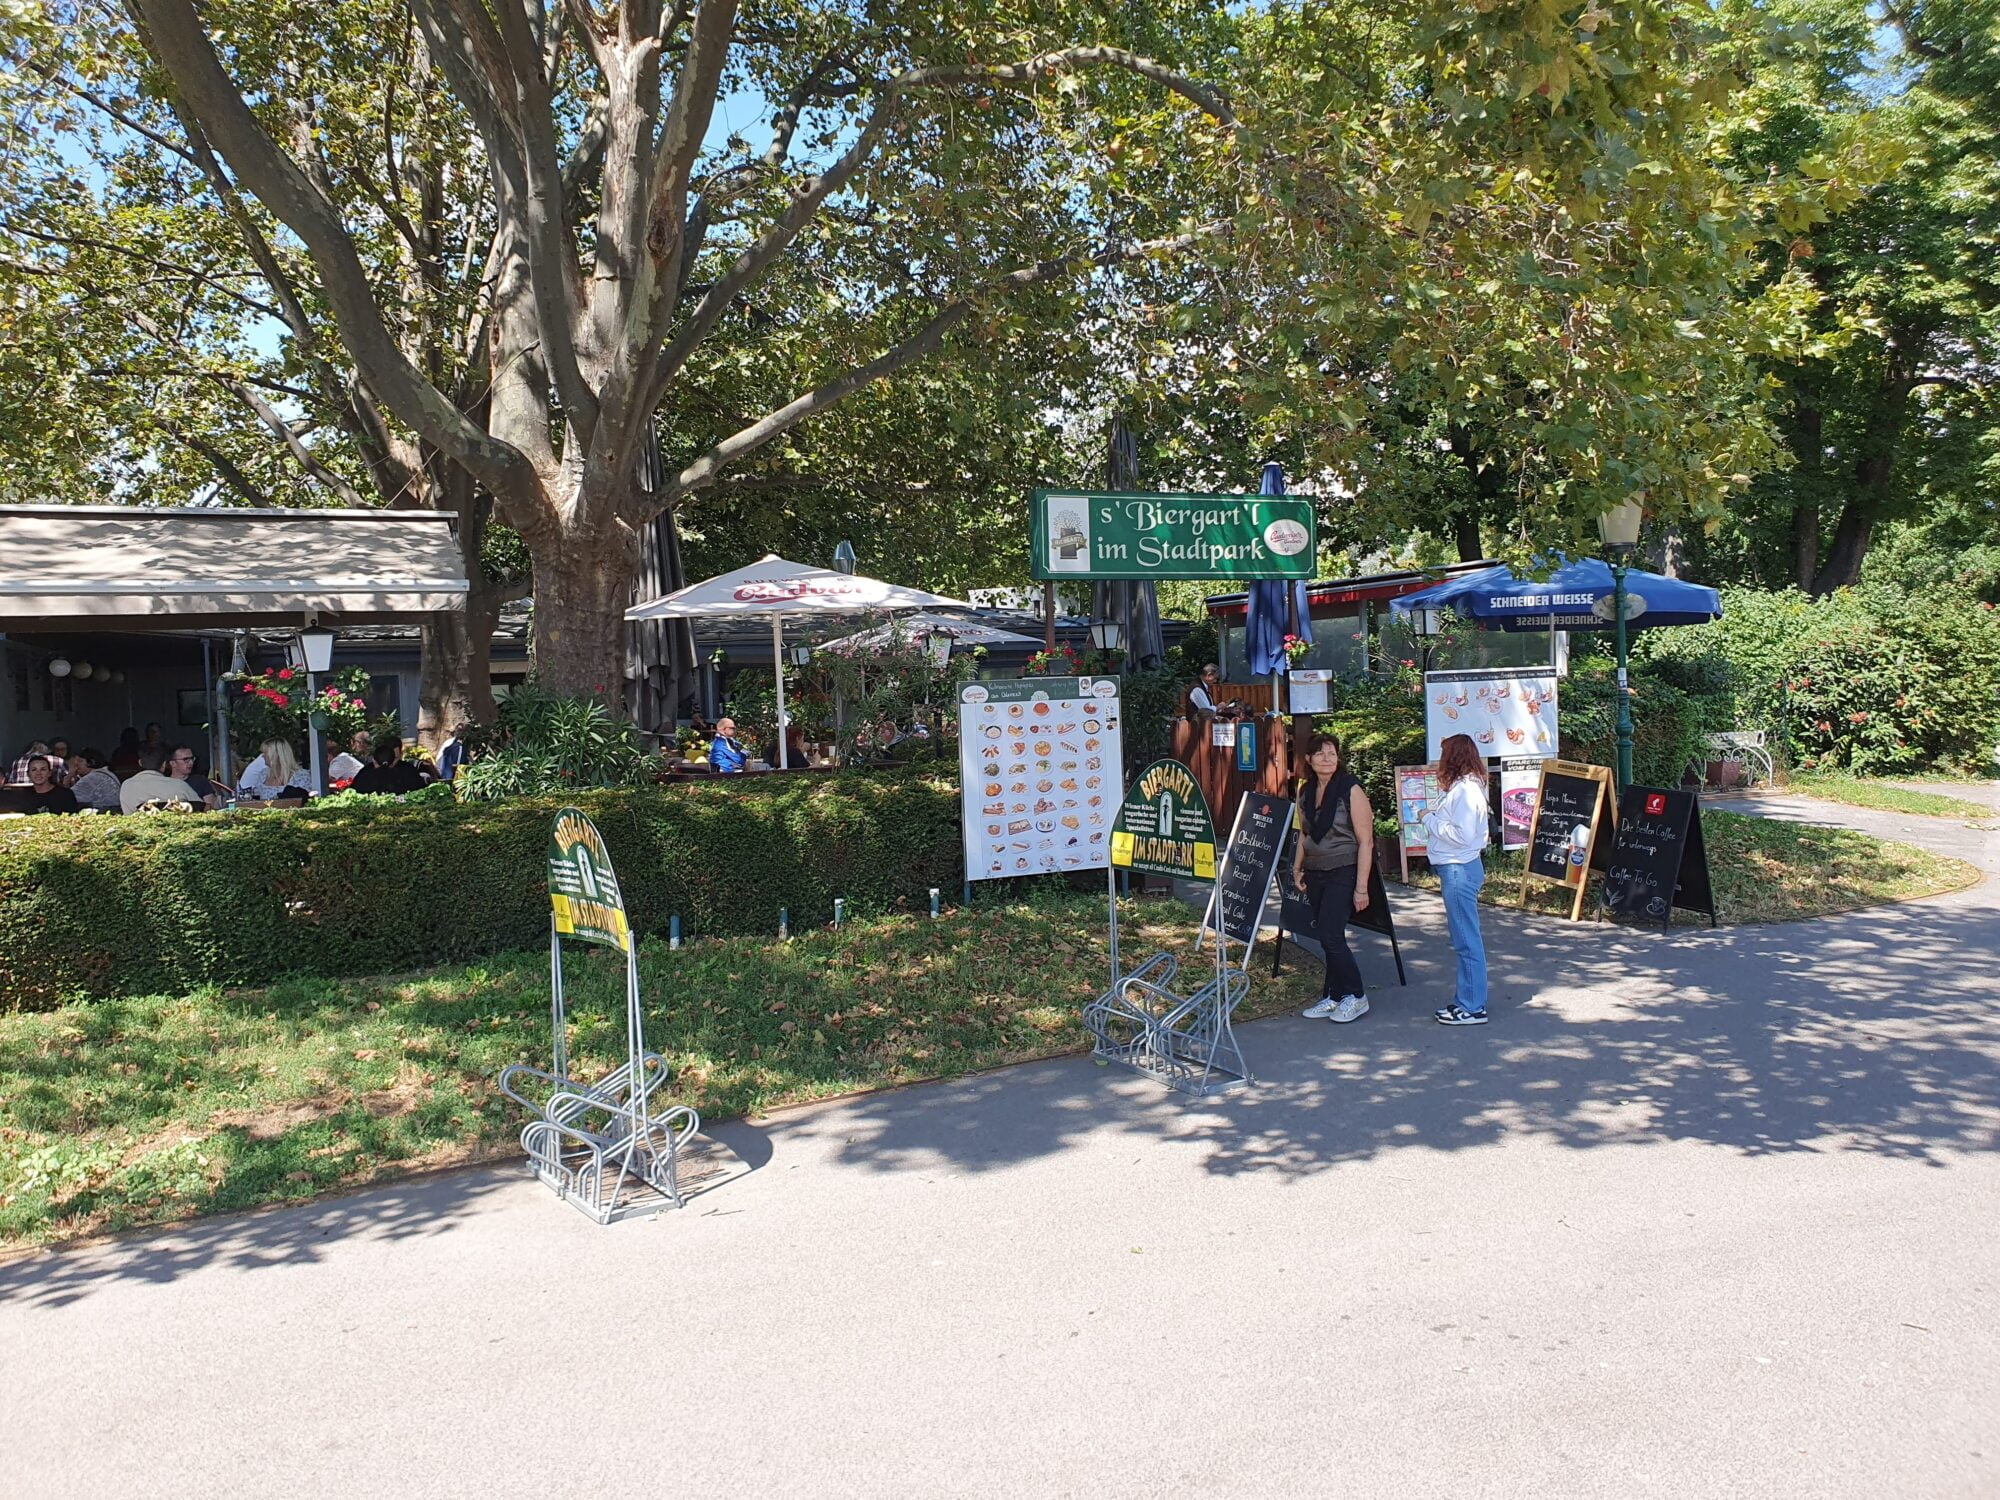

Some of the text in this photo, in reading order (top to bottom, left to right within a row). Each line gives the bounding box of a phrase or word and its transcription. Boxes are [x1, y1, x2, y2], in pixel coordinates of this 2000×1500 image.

[1097, 536, 1266, 569] im Stadtpark
[1490, 593, 1594, 609] SCHNEIDER WEISSE
[1139, 763, 1194, 805] BIERGARTL
[1621, 818, 1634, 832] Die
[1636, 820, 1655, 835] besten
[1134, 835, 1193, 868] IM STADTPRK
[1238, 829, 1272, 852] Obstkuchen
[1232, 864, 1254, 888] Rezept
[1609, 865, 1658, 887] Coffee To Go
